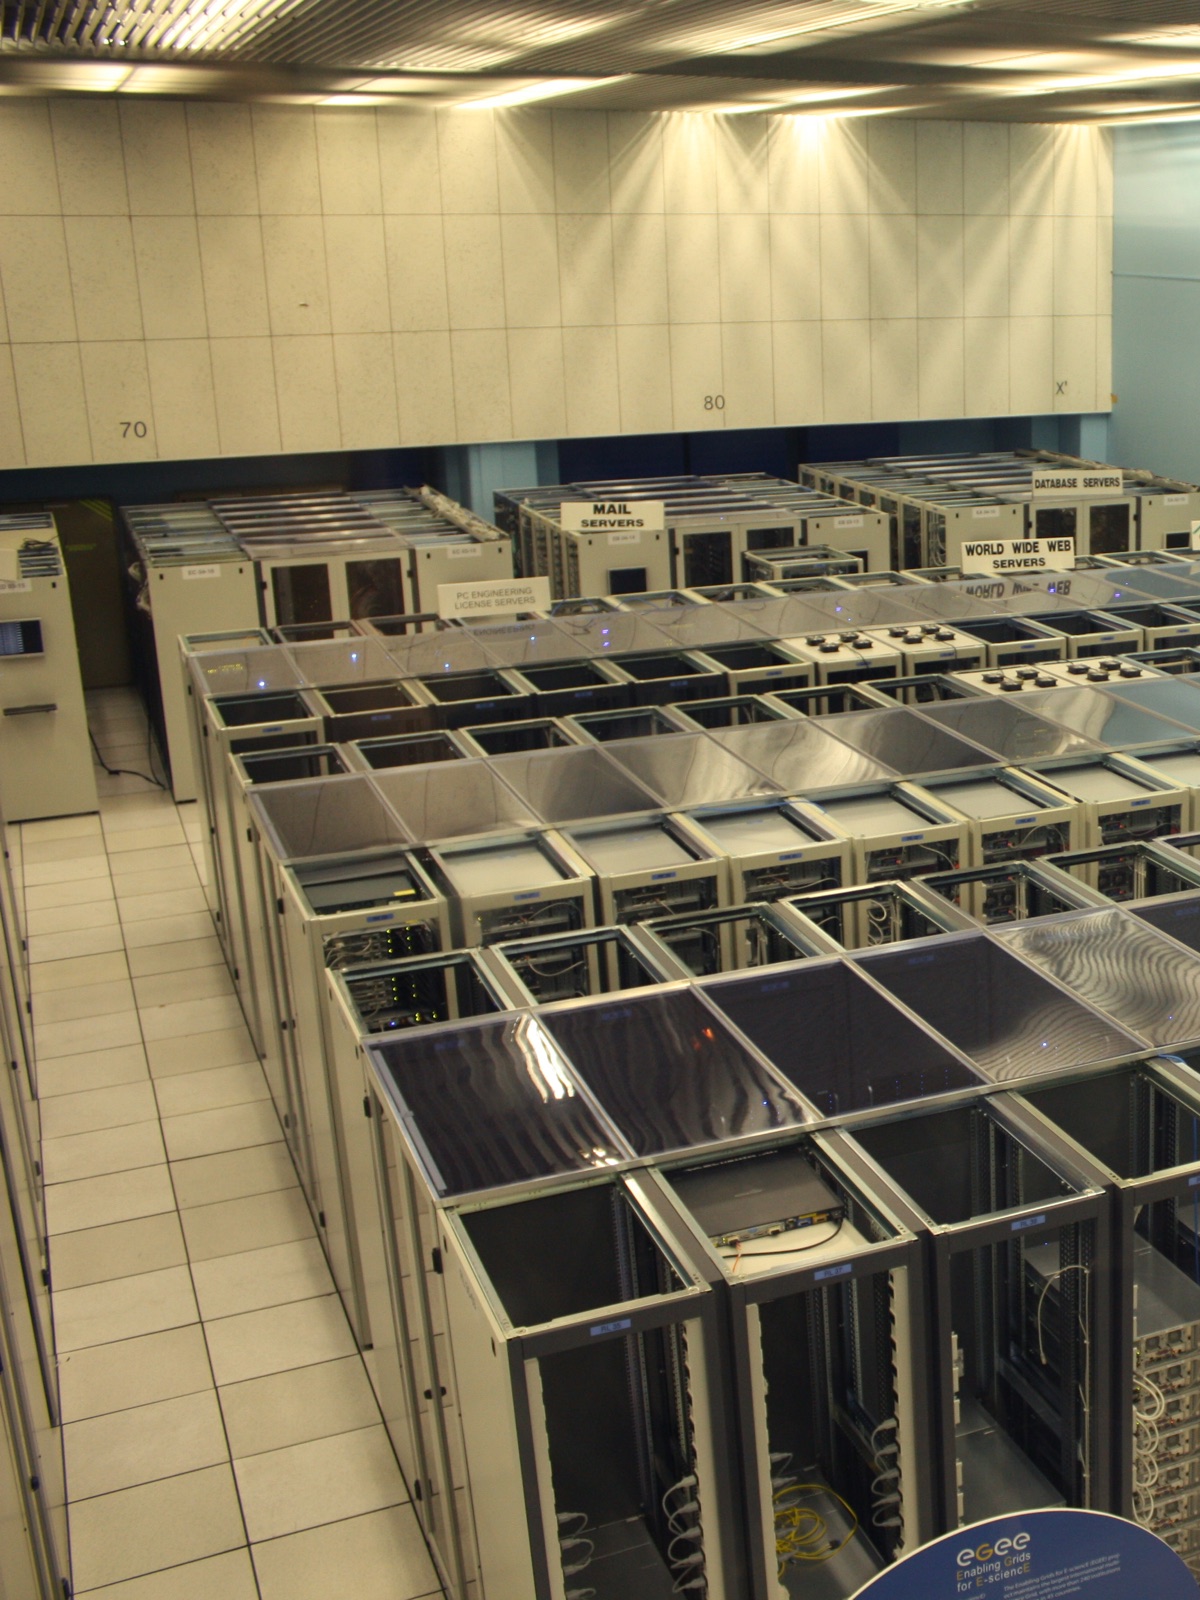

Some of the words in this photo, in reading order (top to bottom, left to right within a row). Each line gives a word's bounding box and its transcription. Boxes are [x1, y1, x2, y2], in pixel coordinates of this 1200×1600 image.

[703, 394, 726, 411] 80
[119, 421, 147, 439] 70
[1034, 478, 1079, 489] DATABASE
[1082, 476, 1121, 488] SERVERS
[592, 504, 632, 515] MAIL
[580, 517, 645, 528] SERVERS
[965, 543, 1004, 556] WORLD
[1011, 540, 1040, 553] WIDE
[1046, 539, 1071, 552] WEB
[992, 557, 1046, 569] SERVERS
[456, 590, 470, 600] PC
[471, 586, 533, 599] ENGINEERING
[454, 598, 488, 609] LICENSE
[488, 595, 536, 607] SERVERS
[956, 1560, 1001, 1582] Enabling
[1003, 1551, 1031, 1567] Grids
[956, 1580, 972, 1592] for
[975, 1562, 1031, 1587] E-sciencE
